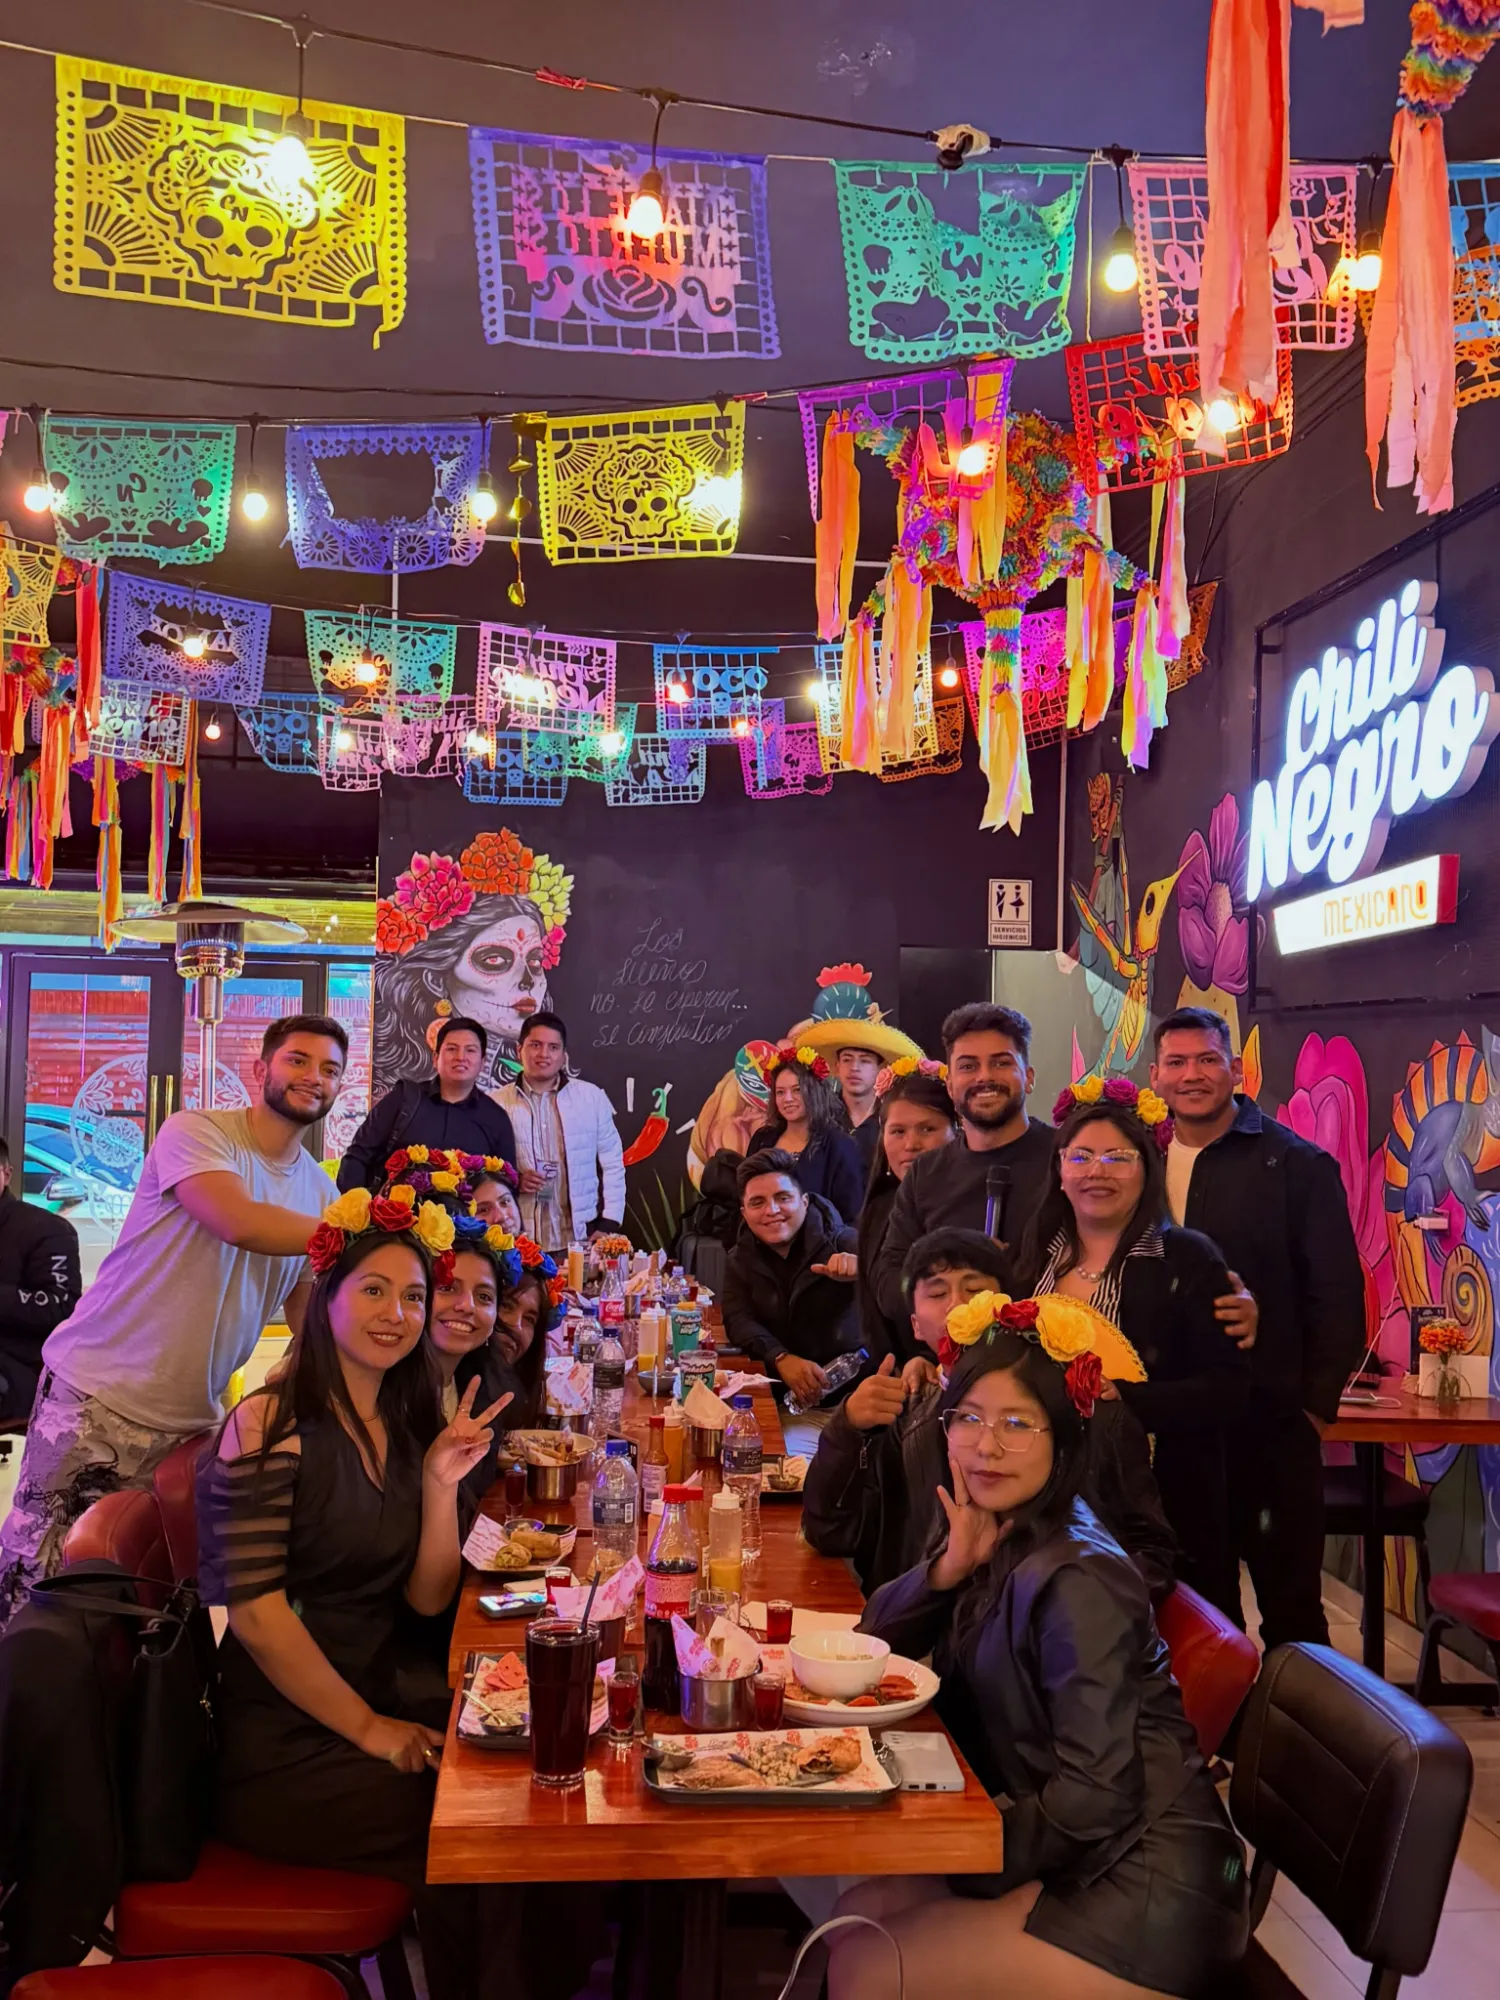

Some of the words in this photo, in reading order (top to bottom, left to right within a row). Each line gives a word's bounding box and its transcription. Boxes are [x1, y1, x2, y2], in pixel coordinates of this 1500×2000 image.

[1286, 578, 1428, 774] Chili
[1246, 663, 1490, 904] Negro
[993, 926, 1026, 934] SERVICIOS
[1323, 879, 1429, 938] MEXICANO
